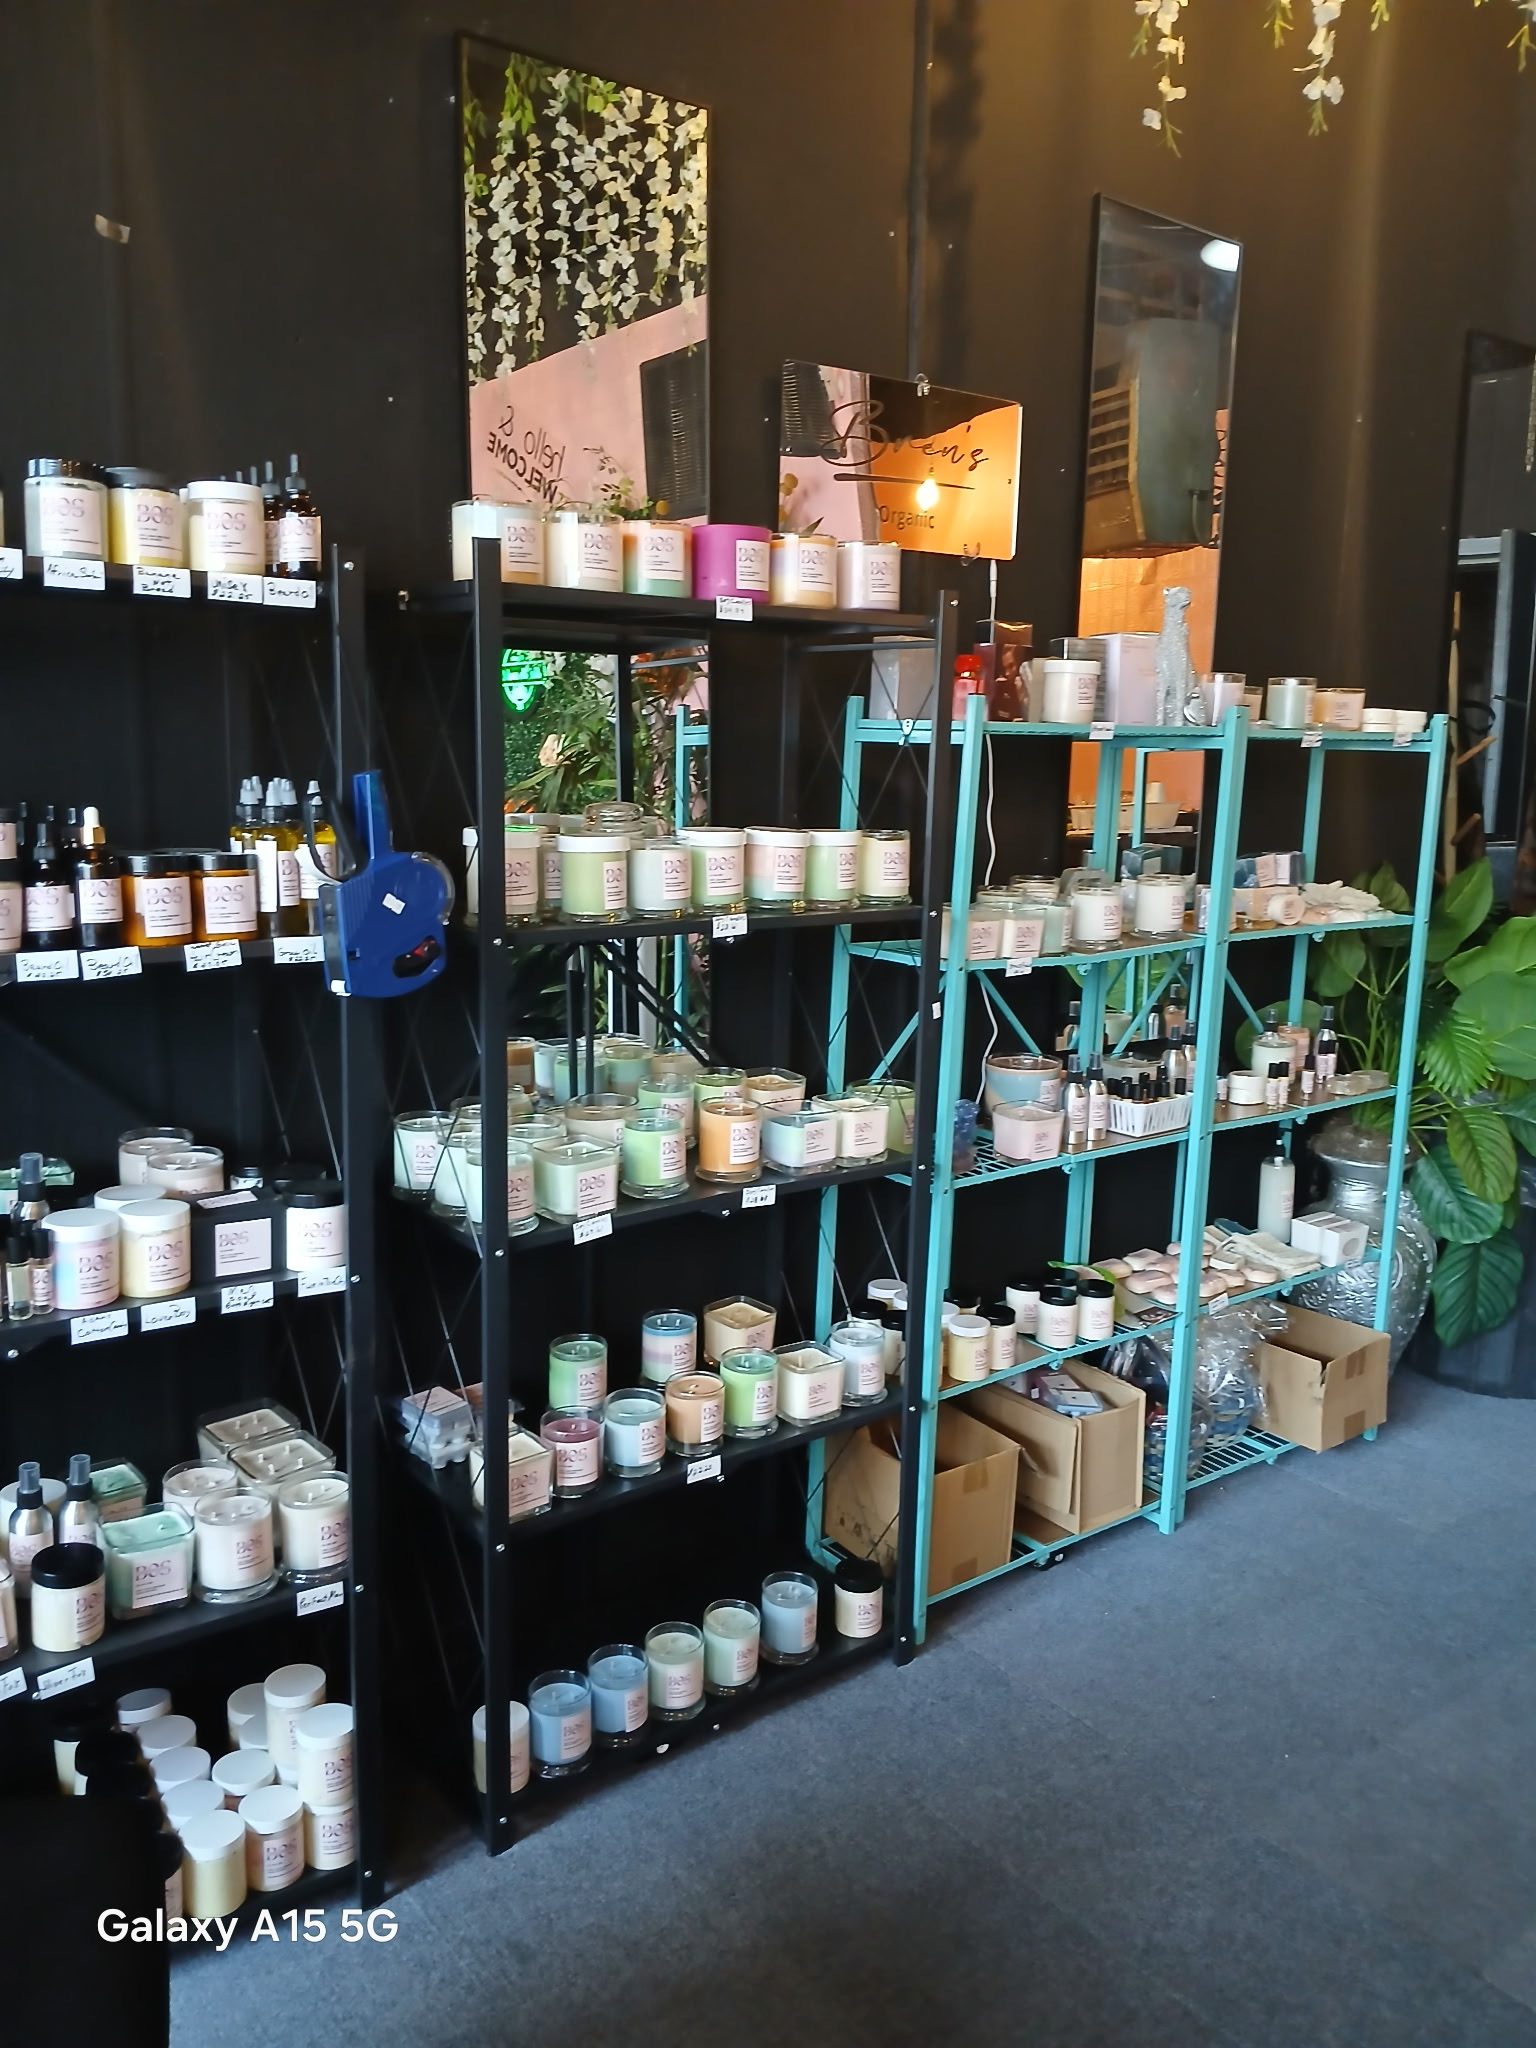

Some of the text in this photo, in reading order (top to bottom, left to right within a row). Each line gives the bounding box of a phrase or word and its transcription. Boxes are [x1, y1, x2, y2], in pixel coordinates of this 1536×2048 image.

[137, 503, 174, 526] BOS
[878, 505, 935, 530] Organic
[146, 885, 184, 906] BOS
[206, 884, 245, 903] BOS
[148, 1240, 183, 1262] BOS
[136, 1559, 172, 1582] BOS
